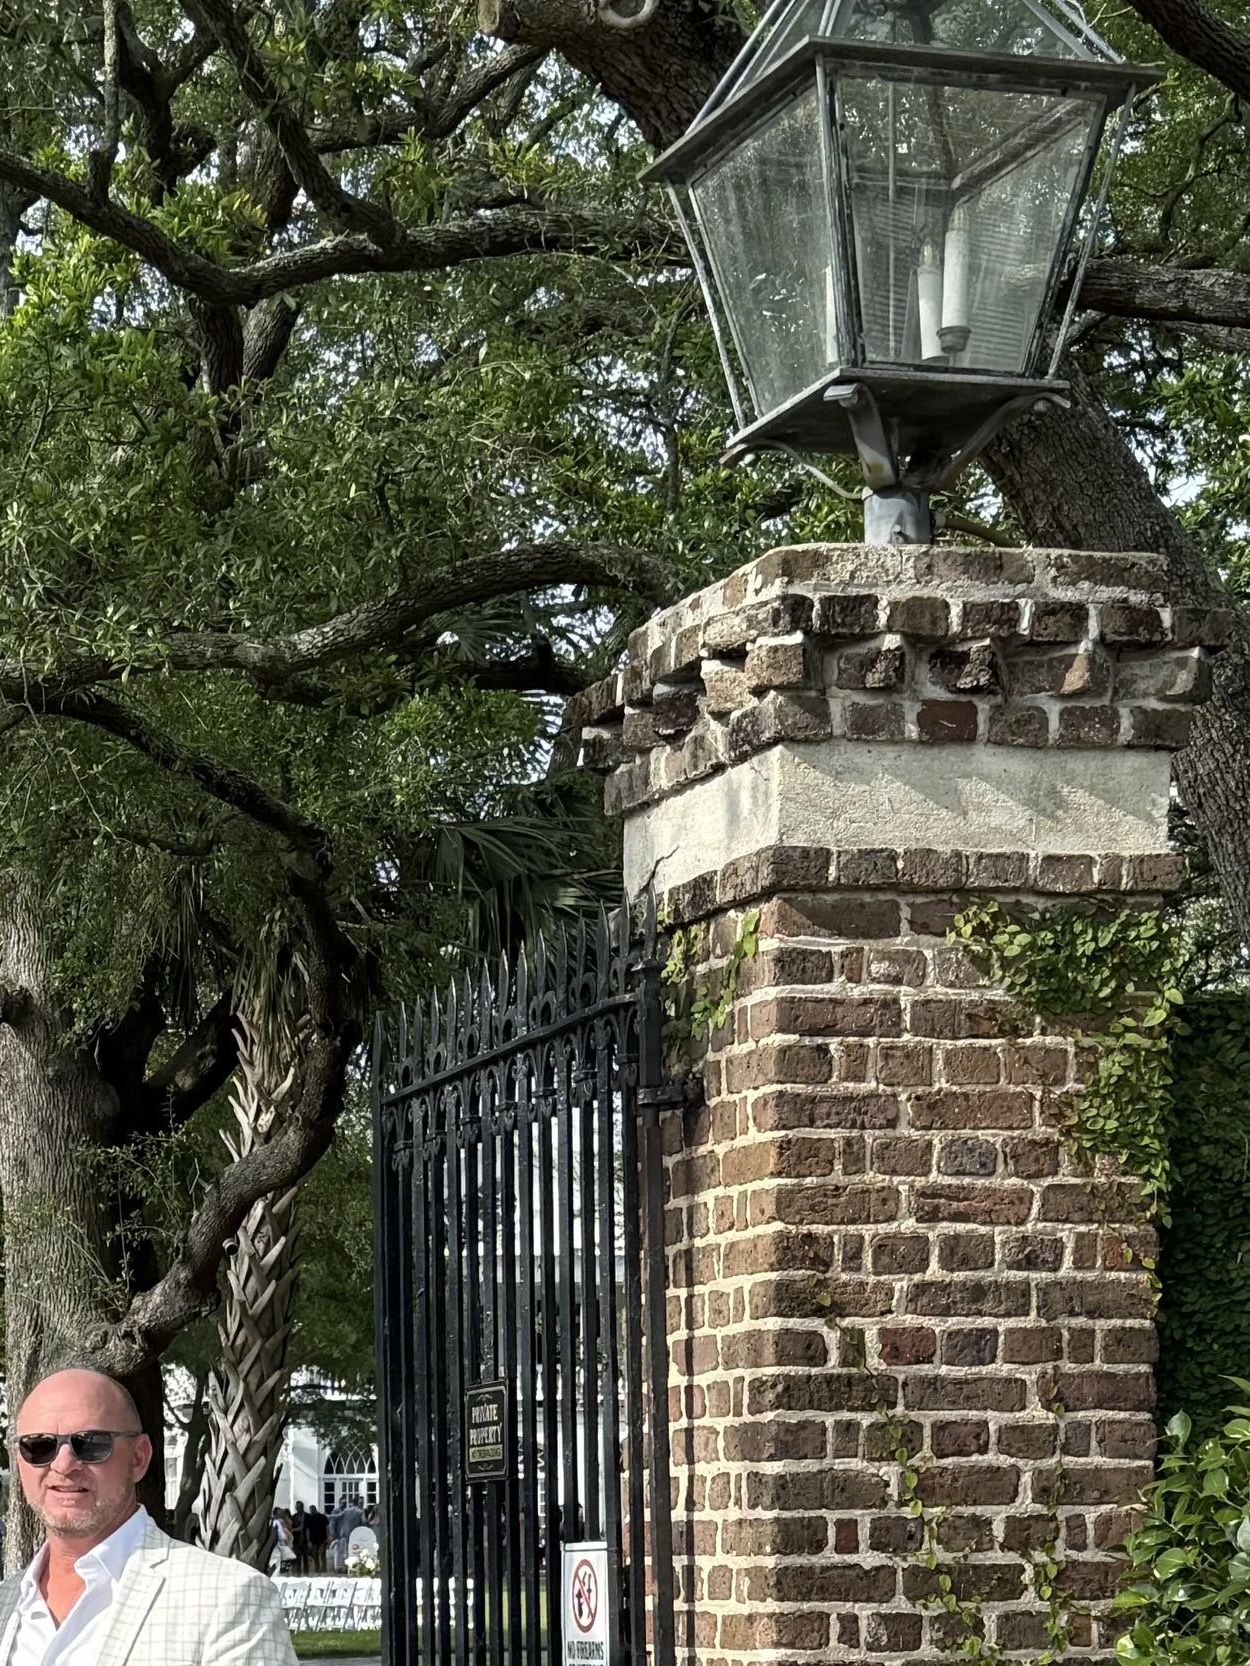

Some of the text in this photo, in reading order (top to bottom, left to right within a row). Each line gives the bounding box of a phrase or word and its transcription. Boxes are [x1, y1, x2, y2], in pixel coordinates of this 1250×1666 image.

[472, 1403, 498, 1424] PRIVATE
[470, 1422, 502, 1445] PROPERTY
[567, 1641, 575, 1659] NO
